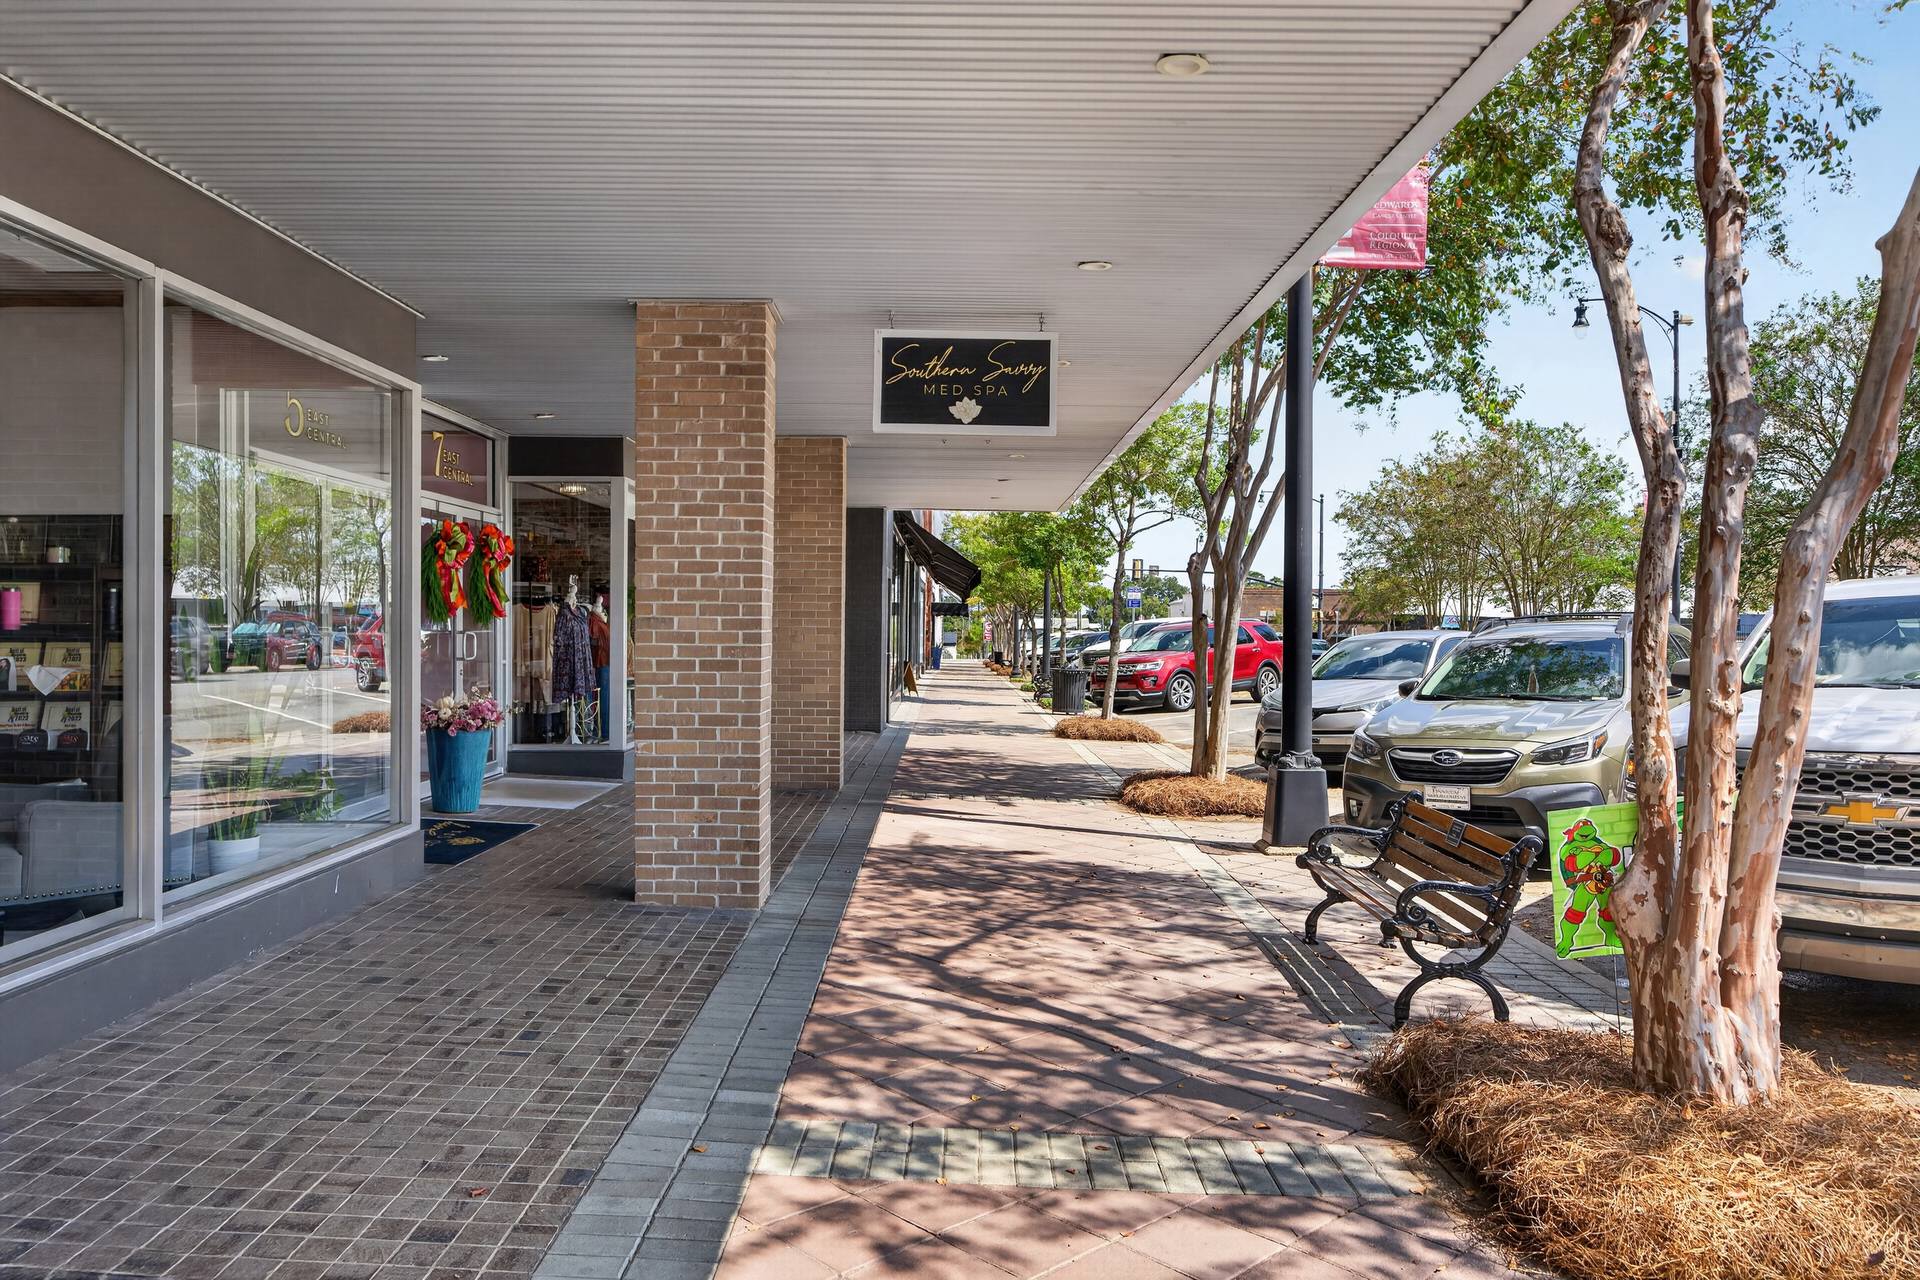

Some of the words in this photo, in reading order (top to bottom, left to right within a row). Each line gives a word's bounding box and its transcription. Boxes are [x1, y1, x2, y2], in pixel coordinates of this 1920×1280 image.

[1369, 241, 1418, 249] REGIONAL
[885, 343, 977, 385] Southern
[982, 341, 1047, 393] Savvy
[923, 384, 964, 396] MED
[973, 385, 1008, 397] SPA
[284, 391, 305, 437] 5
[307, 409, 330, 426] EAST
[306, 426, 347, 449] CENTRAL
[432, 431, 445, 477] 7
[443, 449, 460, 465] EAST
[443, 466, 473, 486] CENTRAL
